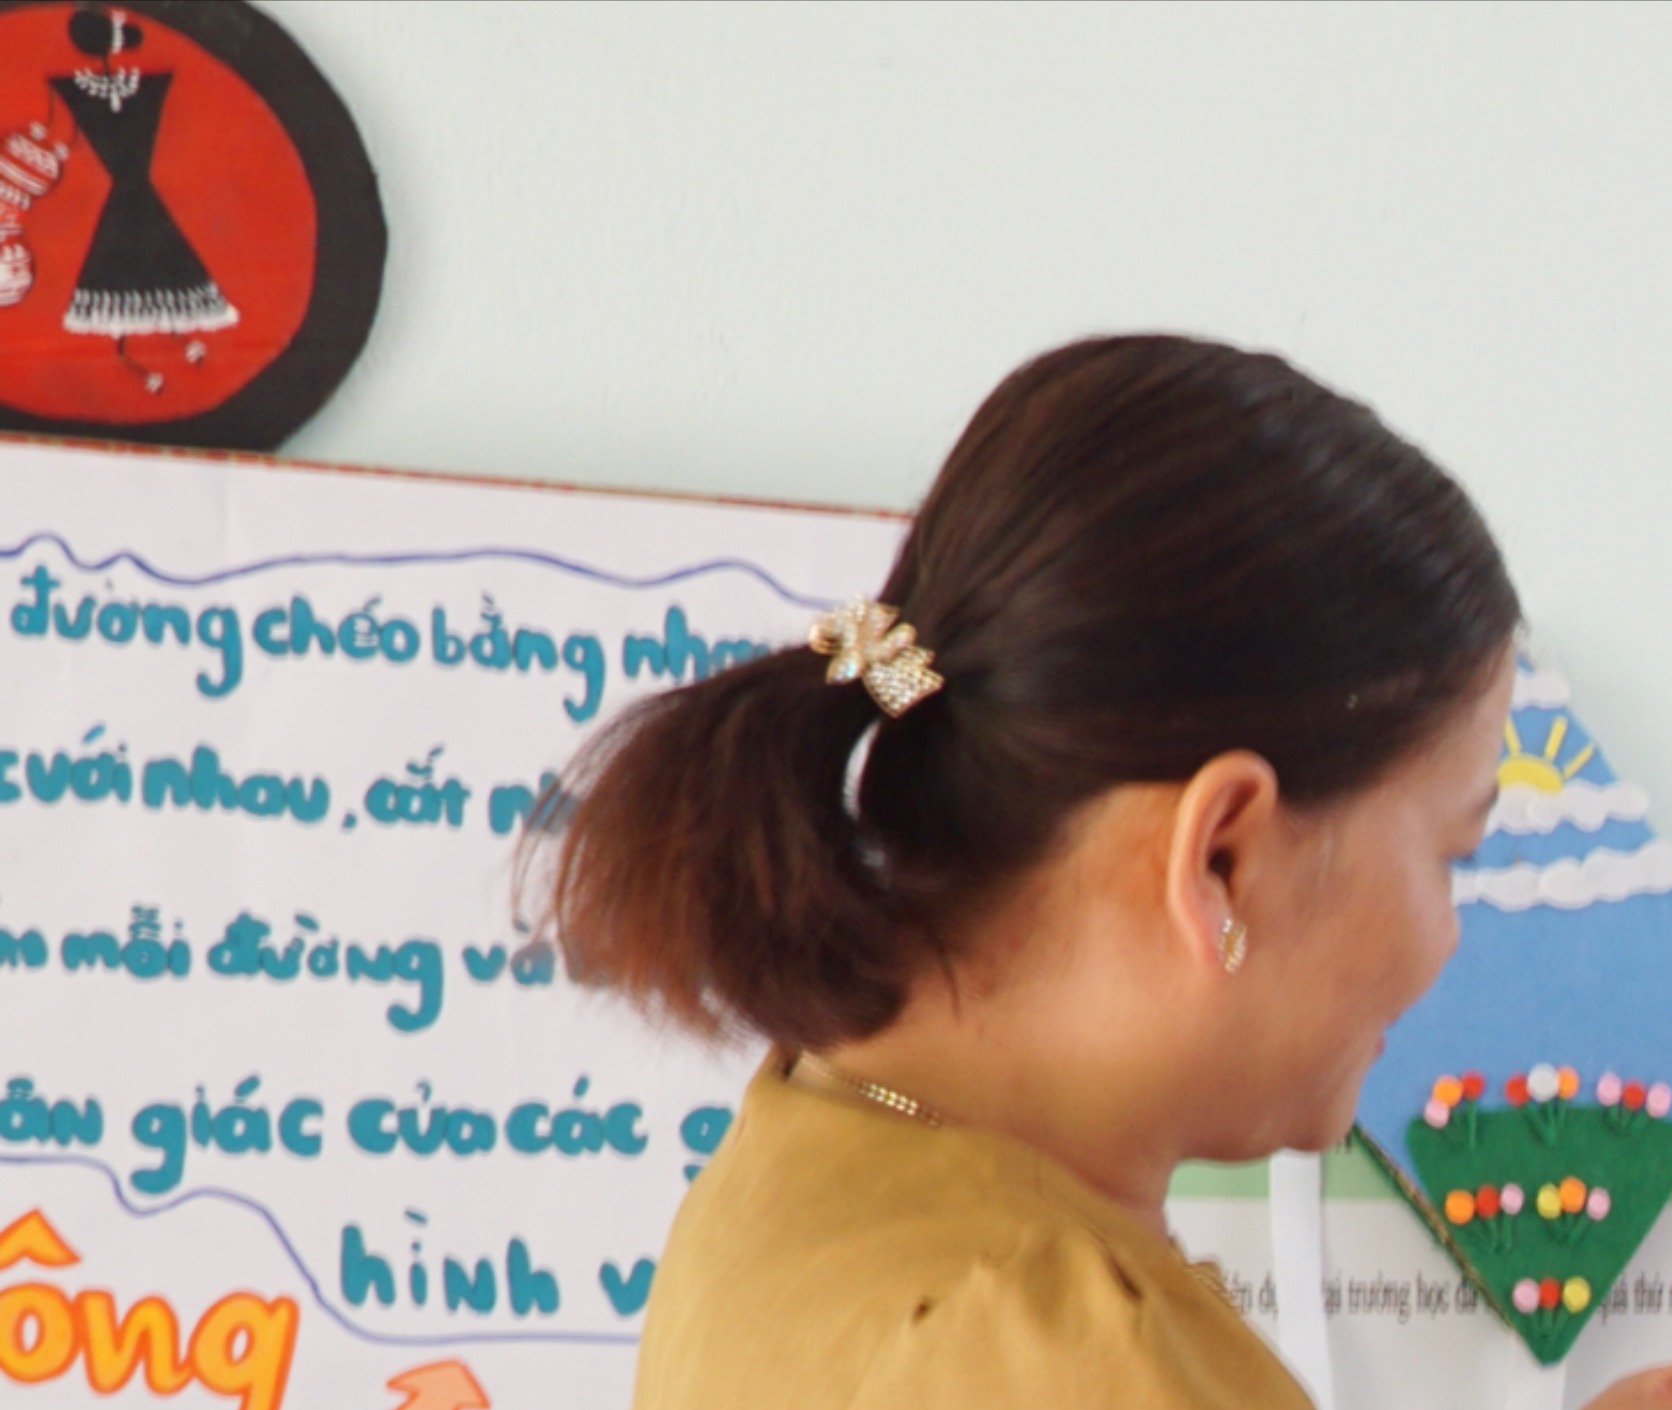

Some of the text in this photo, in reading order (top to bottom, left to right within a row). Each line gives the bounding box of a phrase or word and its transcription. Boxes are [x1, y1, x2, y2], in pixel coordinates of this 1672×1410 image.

[252, 594, 420, 664] chéo
[131, 1074, 324, 1194] giác
[348, 1080, 497, 1156] của
[505, 1075, 648, 1156] các
[341, 1206, 559, 1317] hình
